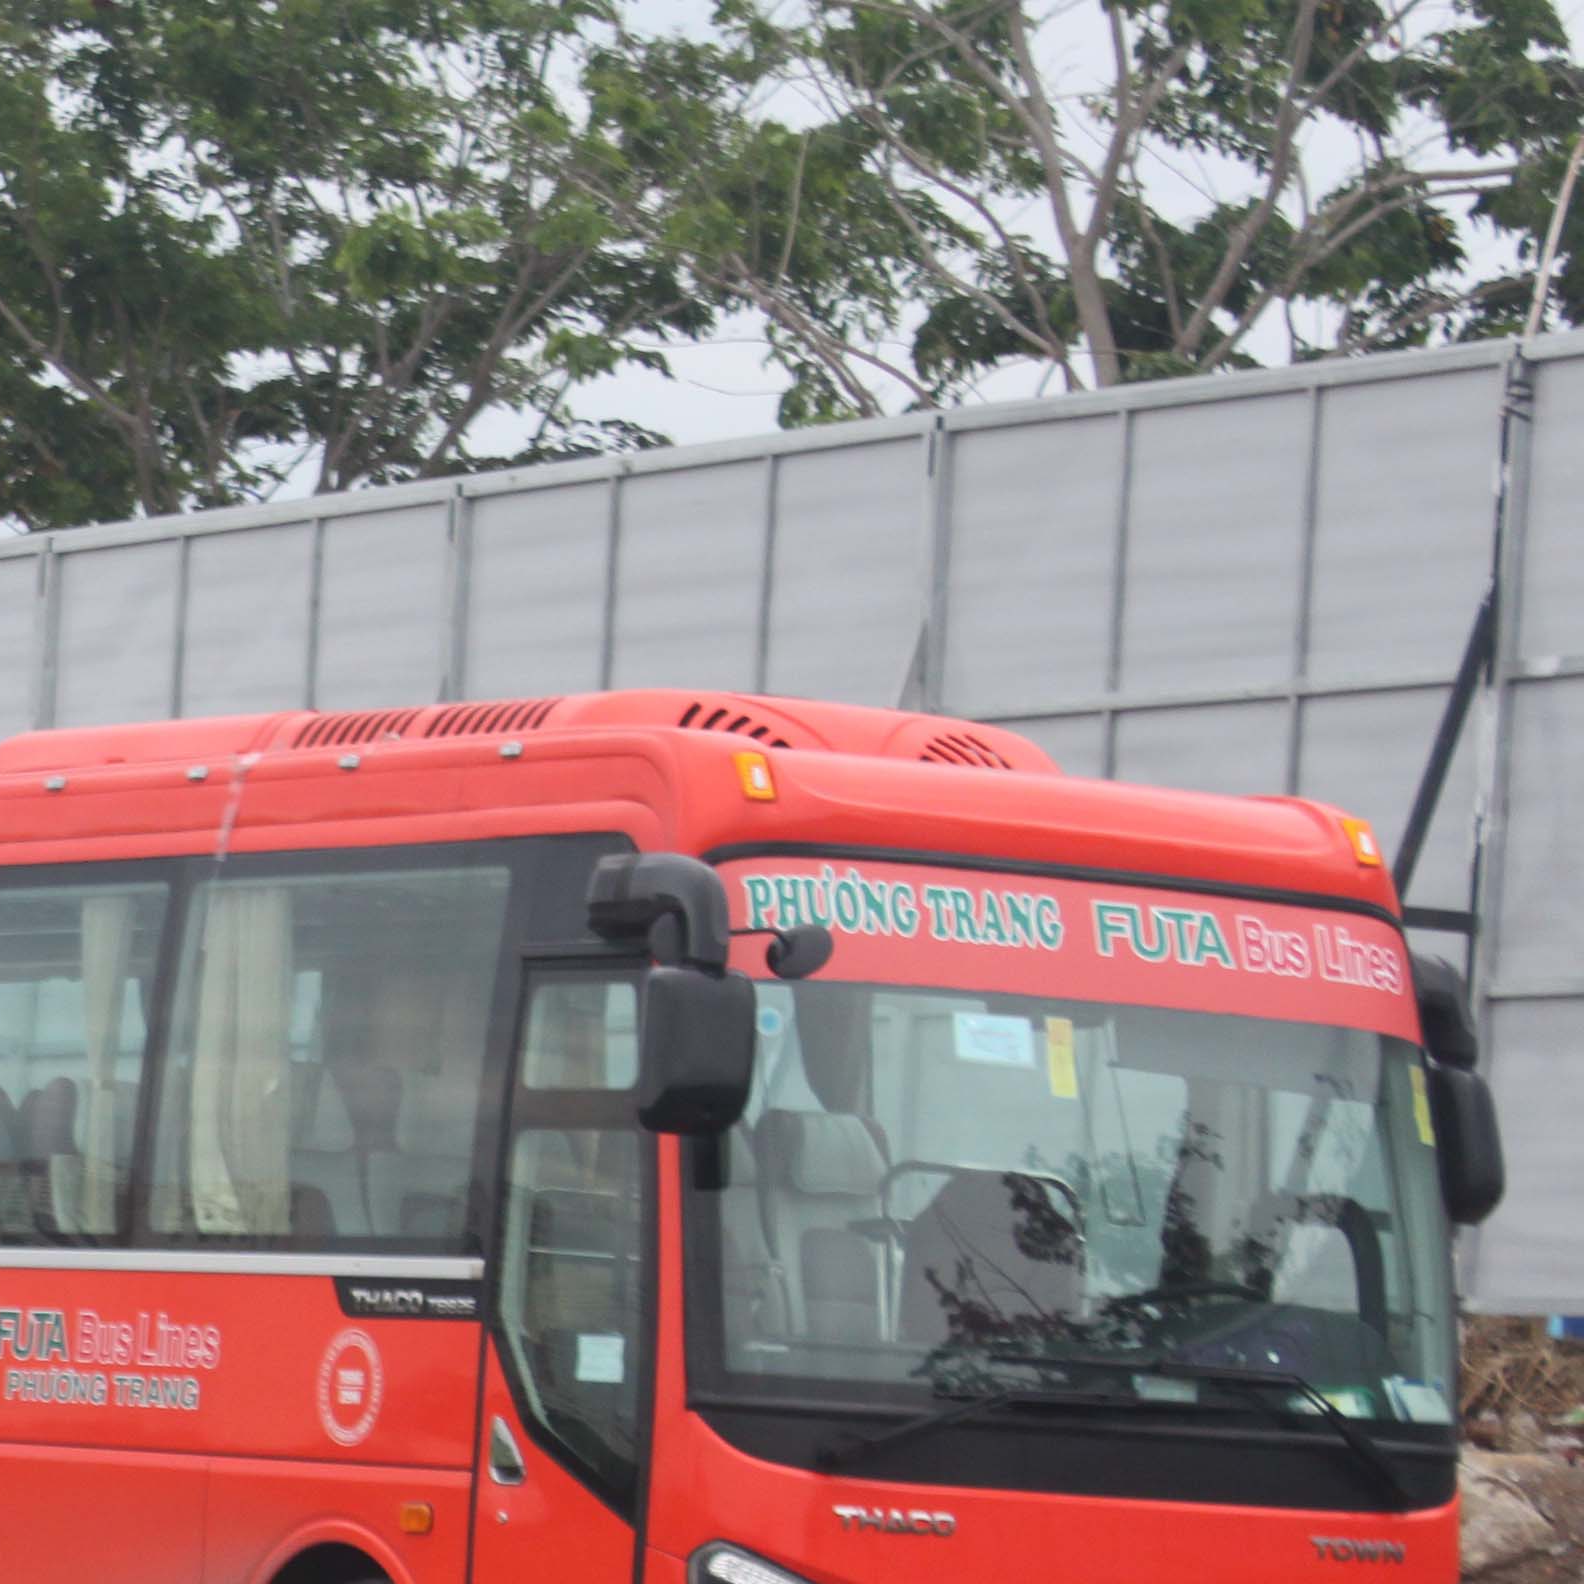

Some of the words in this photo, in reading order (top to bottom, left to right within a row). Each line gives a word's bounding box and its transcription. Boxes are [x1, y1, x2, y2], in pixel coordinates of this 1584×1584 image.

[743, 864, 920, 938] PHƯƠNG
[923, 883, 1063, 950] TRANG
[1091, 900, 1236, 970] FUTA
[1236, 914, 1312, 978] Bus
[1313, 923, 1403, 996] Lines
[74, 1310, 135, 1366] Bus
[136, 1310, 221, 1370] Lines
[111, 1373, 201, 1410] TRANG
[832, 1504, 956, 1537] THACO
[1309, 1535, 1406, 1566] TOWN
